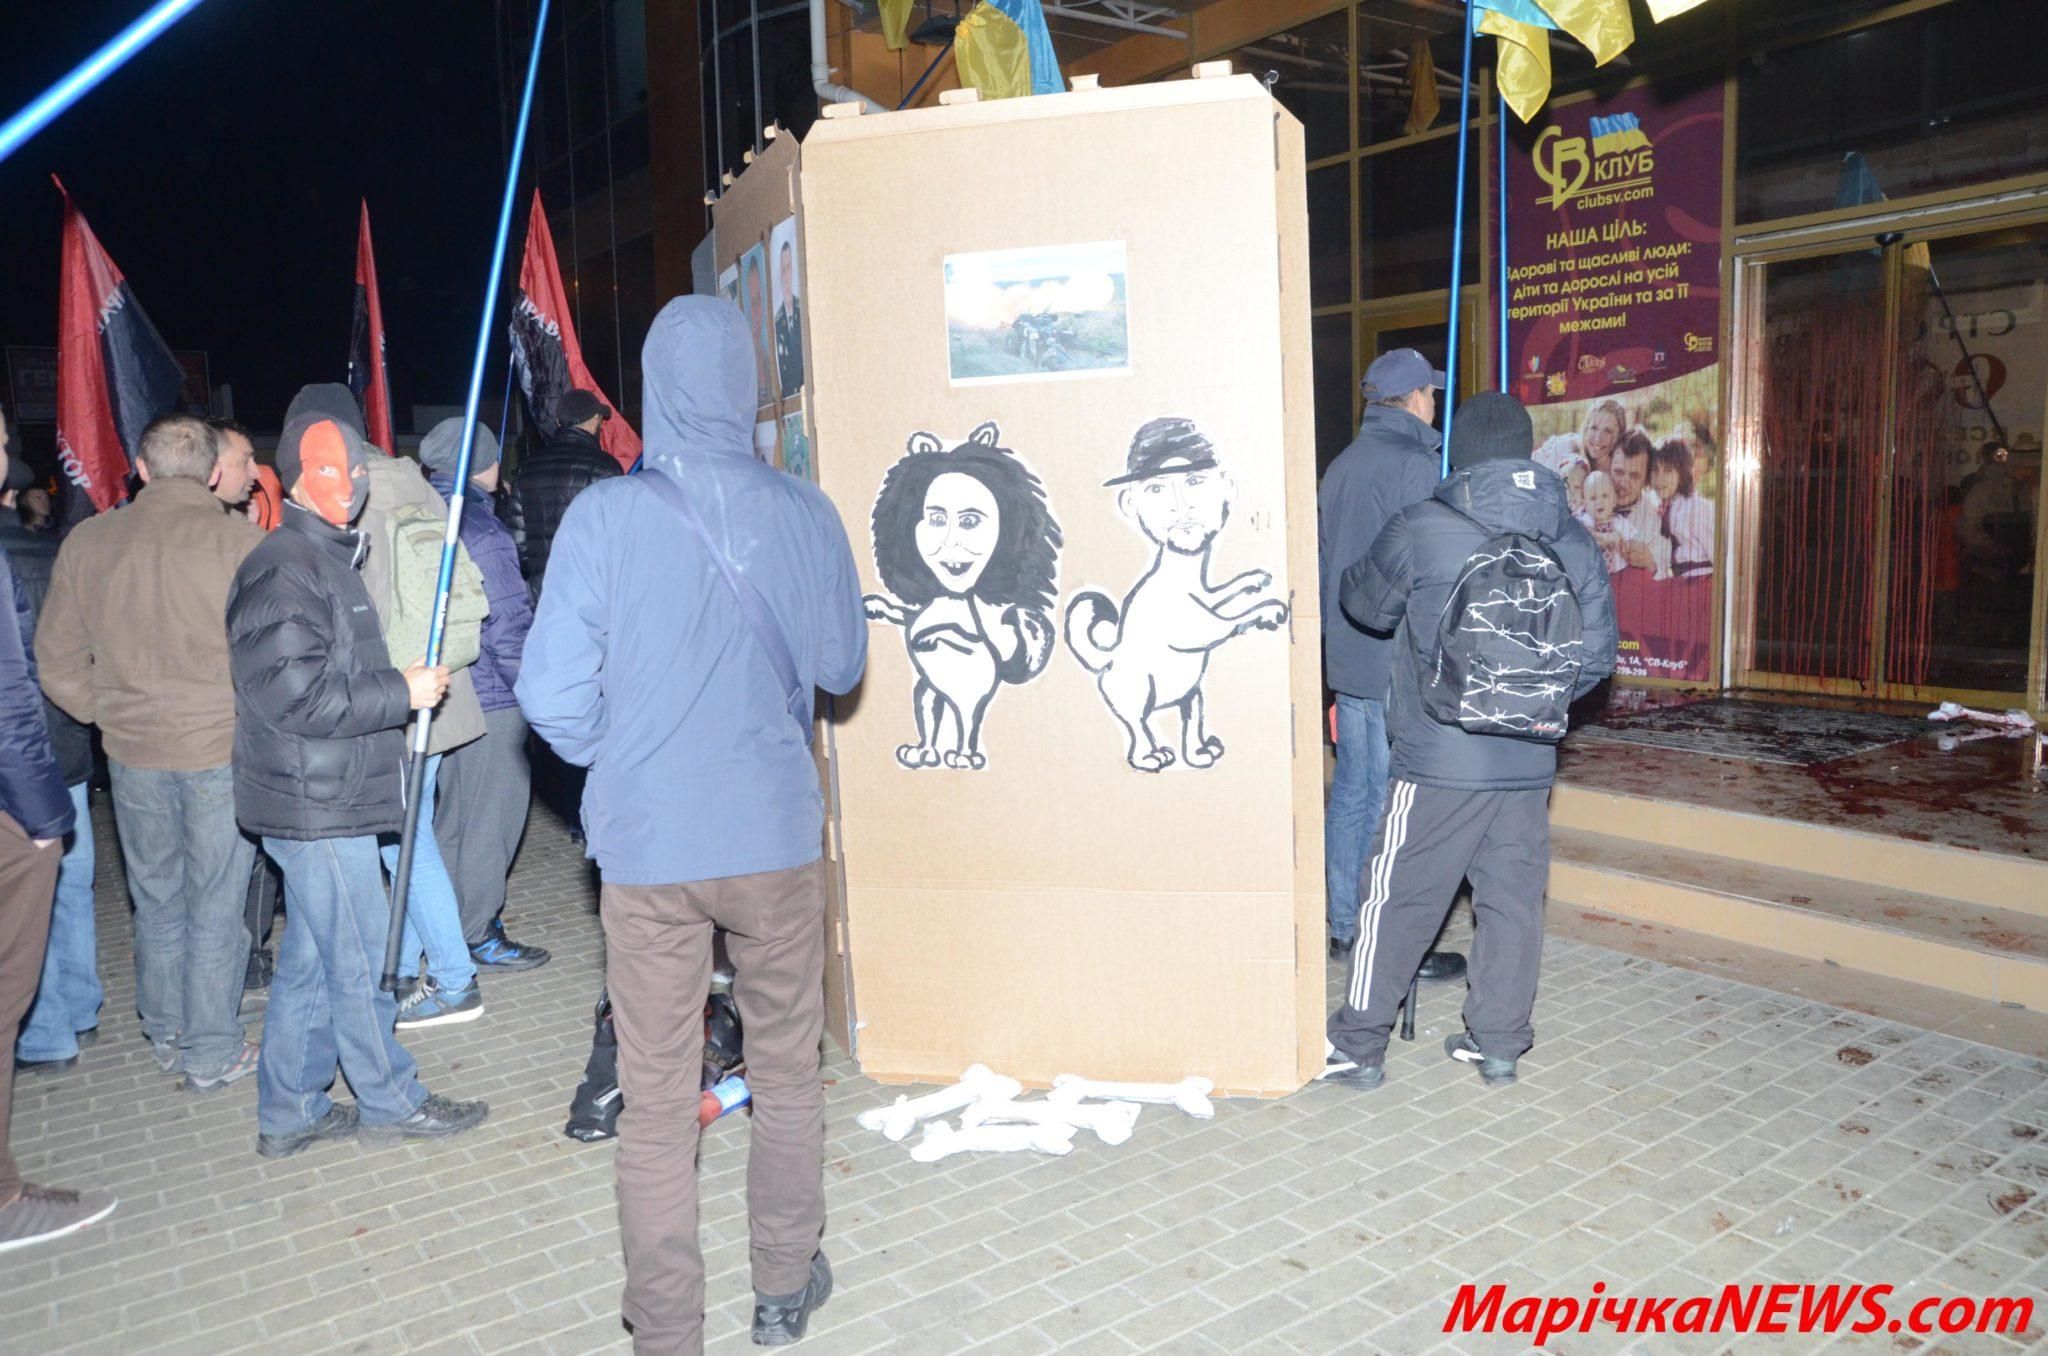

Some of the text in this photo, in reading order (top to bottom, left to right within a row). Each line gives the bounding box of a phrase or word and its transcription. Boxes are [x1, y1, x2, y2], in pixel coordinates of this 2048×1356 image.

[1594, 150, 1654, 182] КЛУБ
[1577, 186, 1654, 210] clubsv.com
[1546, 226, 1599, 251] НАША
[1559, 259, 1576, 272] та
[1578, 246, 1641, 271] щасливі
[1642, 242, 1692, 260] люди:
[1513, 262, 1680, 302] діти та дорослі на усій
[1572, 292, 1633, 313] України
[1635, 290, 1654, 304] та
[1655, 288, 1675, 302] за
[1558, 311, 1627, 334] межами!
